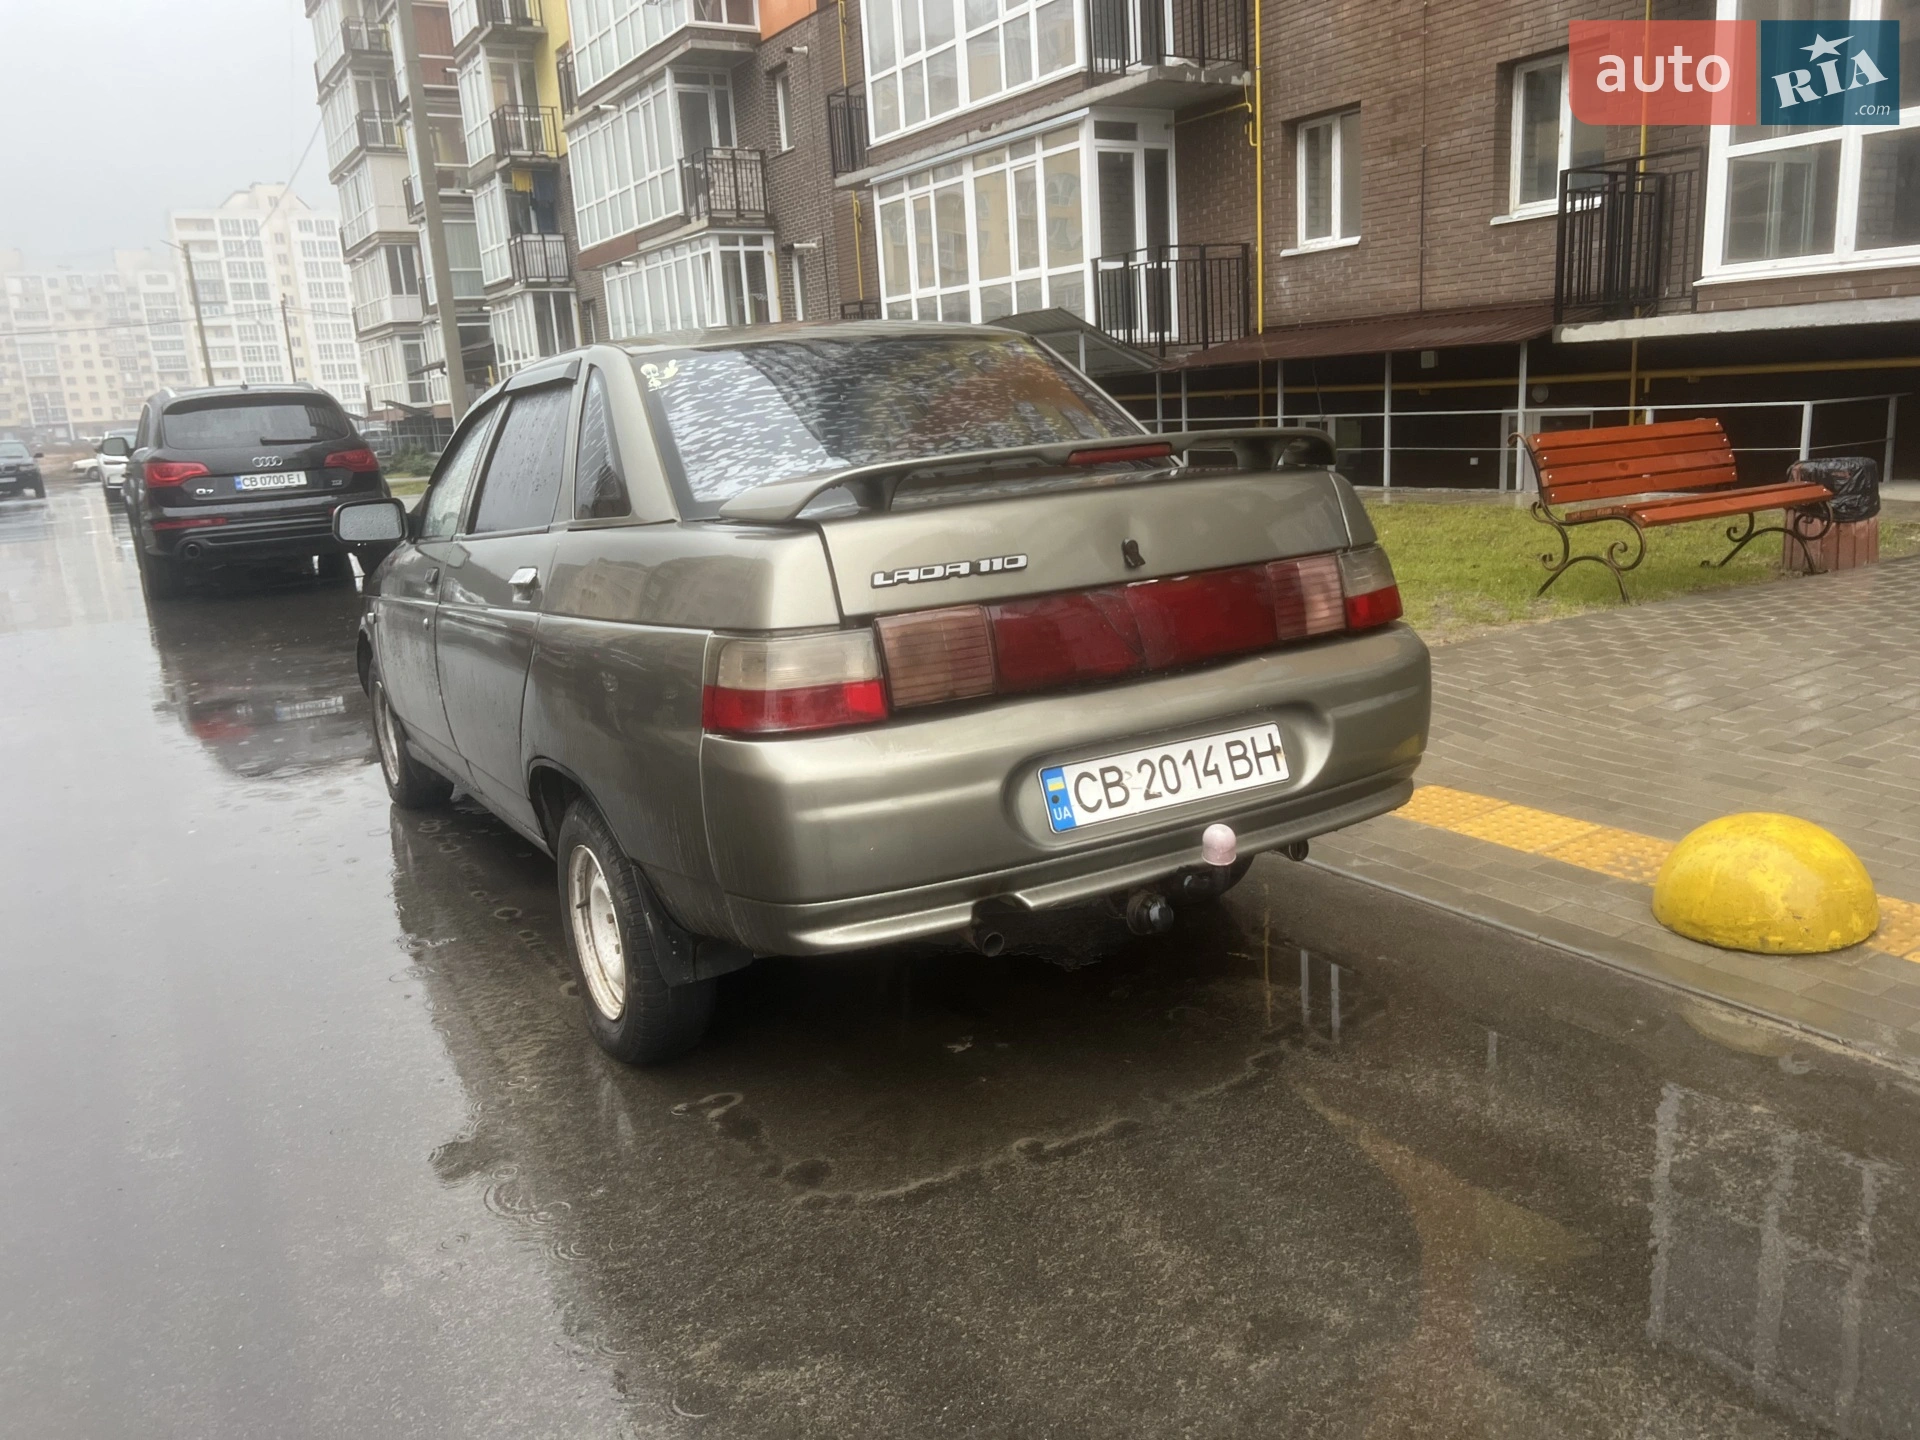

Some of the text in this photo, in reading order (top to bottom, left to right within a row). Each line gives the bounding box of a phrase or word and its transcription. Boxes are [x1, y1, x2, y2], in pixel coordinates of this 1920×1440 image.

[242, 477, 258, 487] CB
[260, 475, 285, 486] 0700
[873, 555, 1028, 586] LADA 110
[1074, 733, 1281, 814] CB 2014 BH
[1053, 807, 1072, 821] UA
